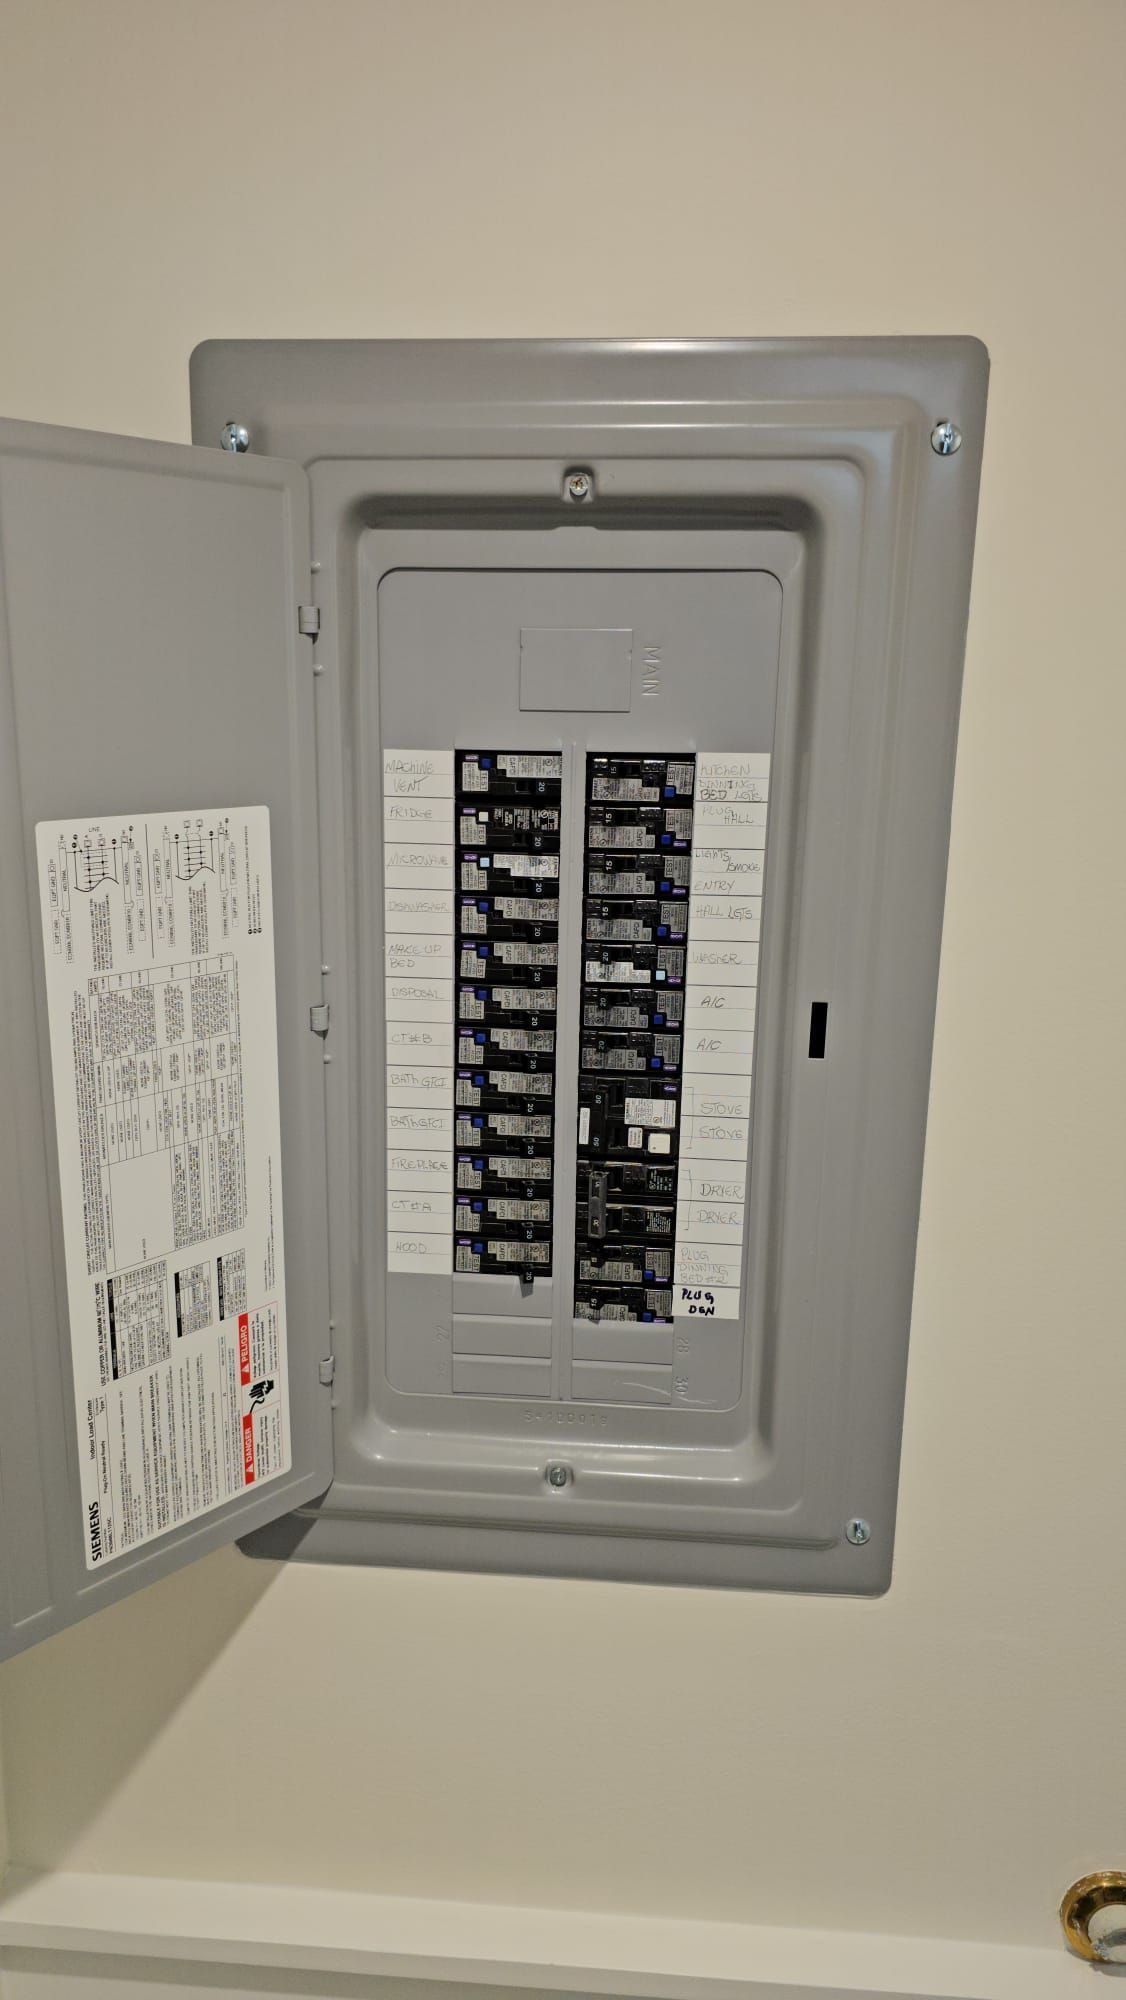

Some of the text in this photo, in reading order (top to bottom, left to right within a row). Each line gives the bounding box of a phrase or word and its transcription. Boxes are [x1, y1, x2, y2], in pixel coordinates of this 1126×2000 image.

[641, 645, 662, 696] MAIN
[610, 766, 617, 774] 15
[394, 776, 428, 792] VENT
[538, 782, 545, 792] 20
[701, 789, 728, 801] BED
[390, 805, 433, 818] FRIDGE
[724, 811, 754, 824] HALL
[605, 813, 612, 823] 15
[535, 837, 541, 847] 20
[606, 860, 612, 871] 15
[535, 883, 542, 893] 20
[694, 879, 736, 895] ENTRY
[602, 907, 609, 917] 15
[695, 904, 724, 917] HALL
[534, 927, 541, 936] 20
[388, 943, 442, 956] MAKE UP
[603, 952, 609, 961] 20
[389, 957, 416, 969] BED
[534, 972, 540, 982] 20
[392, 987, 444, 1000] DISPOSAL
[600, 998, 606, 1007] 20
[701, 996, 726, 1008] A/C
[531, 1017, 537, 1026] 20
[598, 1041, 604, 1050] 20
[697, 1038, 722, 1050] A/C
[530, 1060, 537, 1069] 20
[422, 1076, 448, 1090] GFCI
[527, 1103, 534, 1112] 20
[701, 1101, 744, 1115] STOVE
[700, 1125, 745, 1140] STOVE
[528, 1145, 534, 1155] 20
[391, 1156, 449, 1171] FIREPLACE
[527, 1188, 533, 1197] 20
[700, 1183, 744, 1199] DRYER
[698, 1209, 741, 1225] DRYER
[526, 1230, 533, 1239] 20
[396, 1242, 427, 1254] HOOD
[680, 1246, 710, 1262] PLUG
[526, 1271, 532, 1280] 20
[680, 1274, 703, 1284] BED
[682, 1288, 714, 1304] PLUG
[591, 1298, 597, 1307] 15
[688, 1304, 715, 1316] DEN
[98, 1344, 104, 1353] OR
[240, 1325, 249, 1362] PELIGRO
[675, 1376, 689, 1393] 30
[245, 1428, 253, 1461] DANGER
[88, 1502, 102, 1561] SIEMENS
